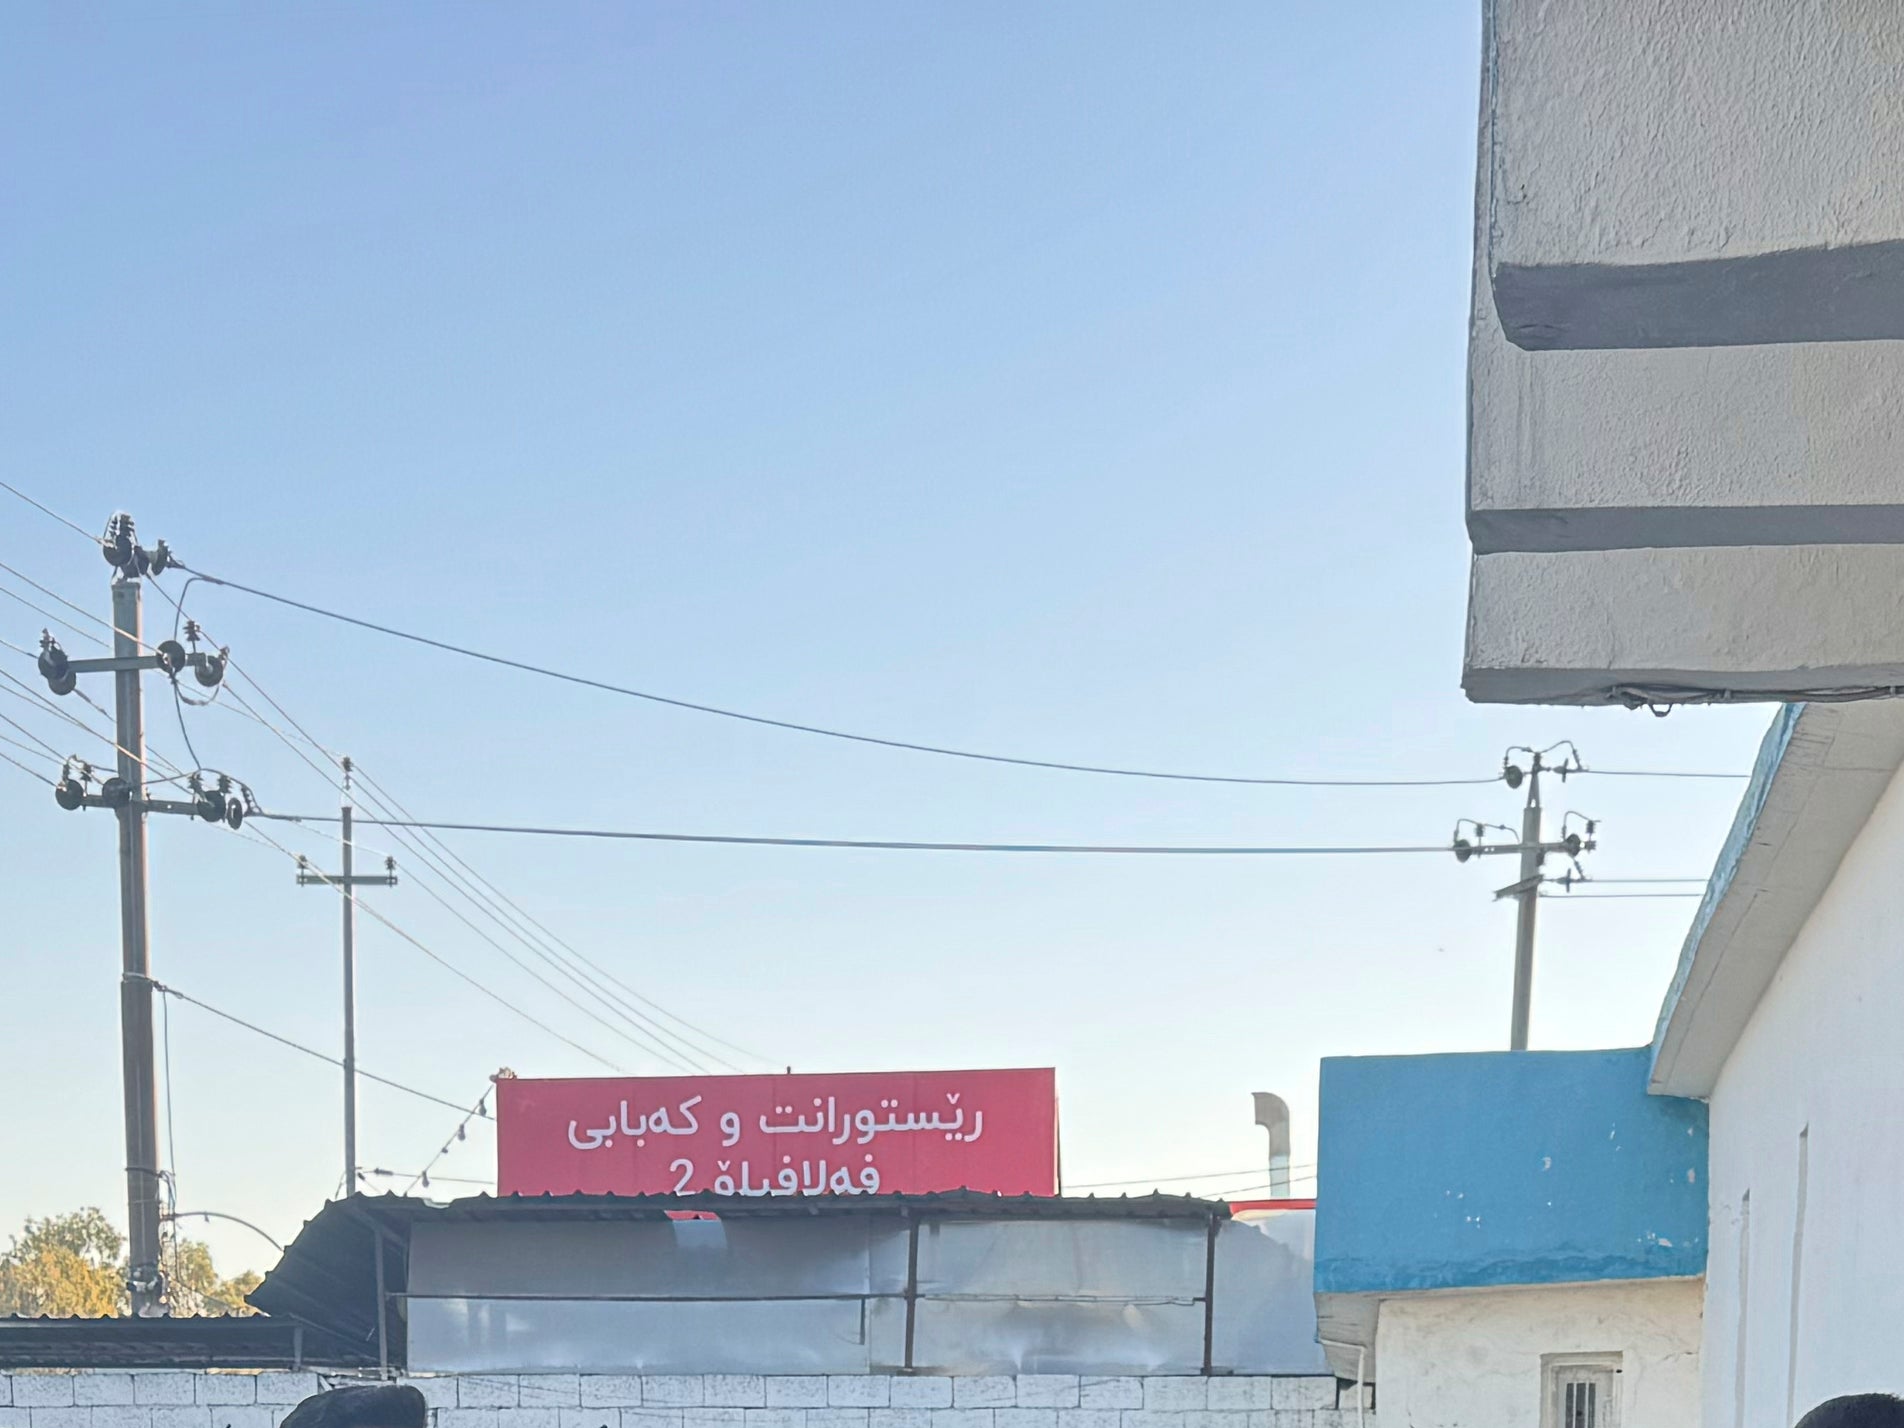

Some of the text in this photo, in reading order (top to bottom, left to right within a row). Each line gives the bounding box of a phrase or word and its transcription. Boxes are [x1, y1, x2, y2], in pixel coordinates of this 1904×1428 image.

[568, 1092, 984, 1151] رێستورانت و کەبابی
[669, 1158, 697, 1197] 2
